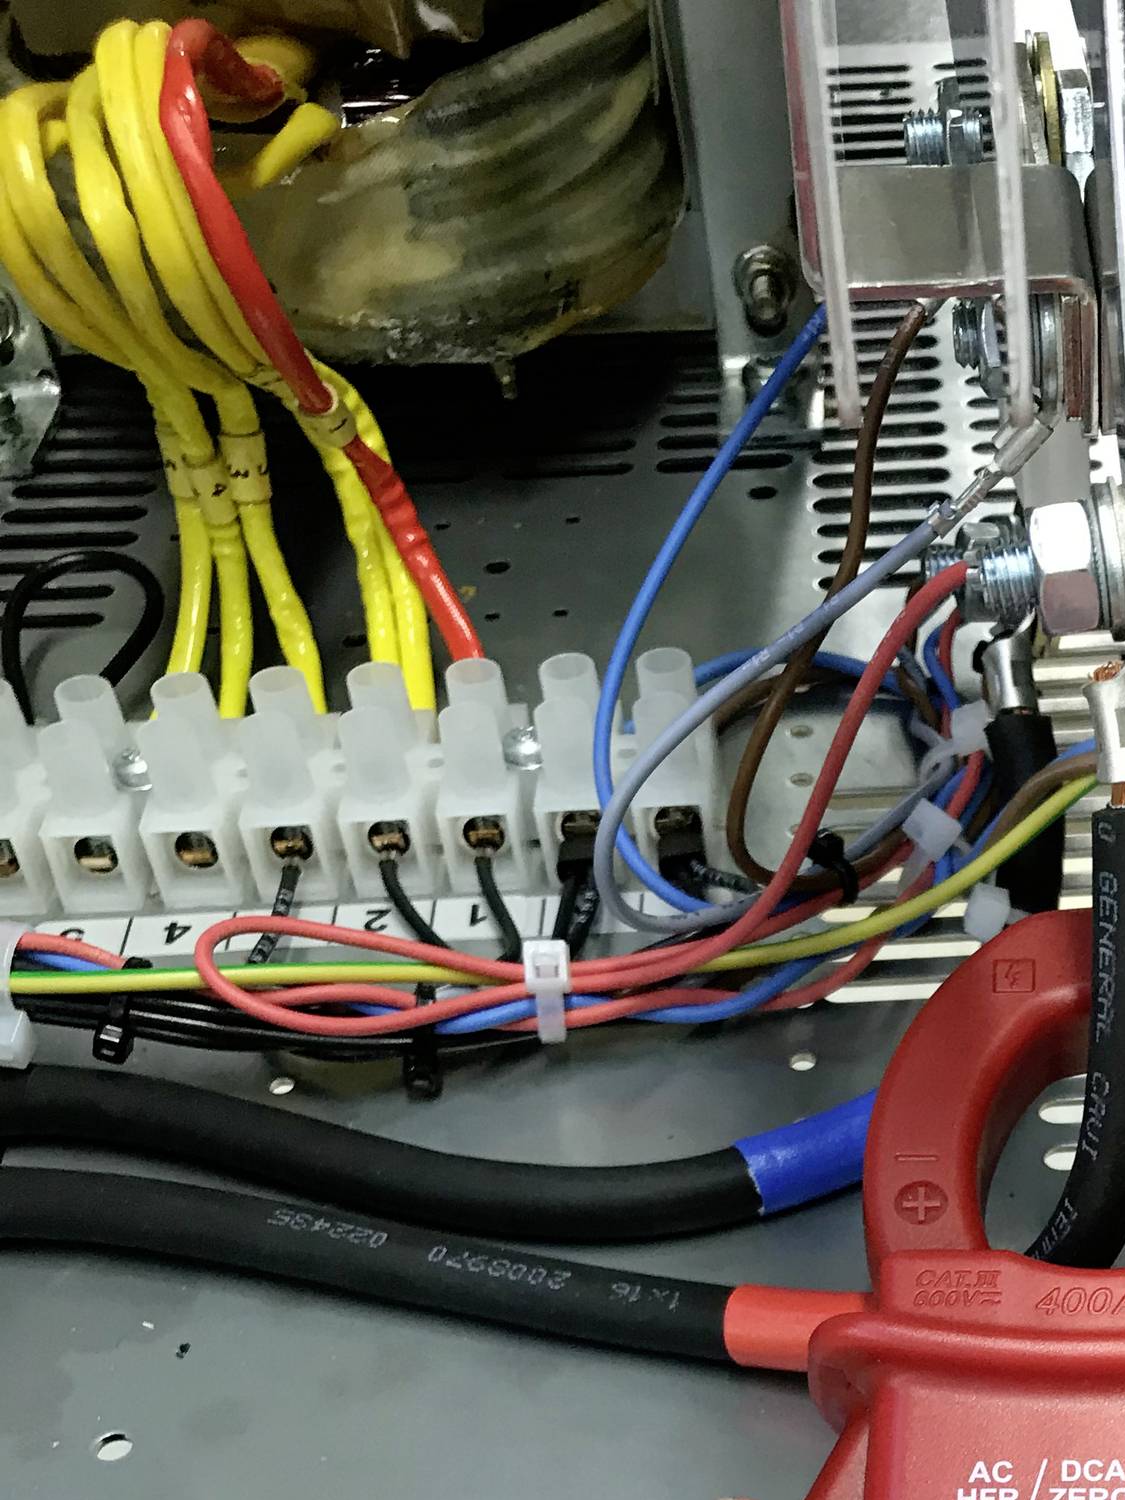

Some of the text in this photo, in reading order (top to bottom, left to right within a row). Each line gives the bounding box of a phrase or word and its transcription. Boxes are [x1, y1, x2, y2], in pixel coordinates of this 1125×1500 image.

[363, 908, 392, 932] 2
[469, 903, 488, 927] 1
[163, 921, 192, 946] 4
[1096, 871, 1119, 1044] GENERAL
[968, 1460, 1014, 1484] AC
